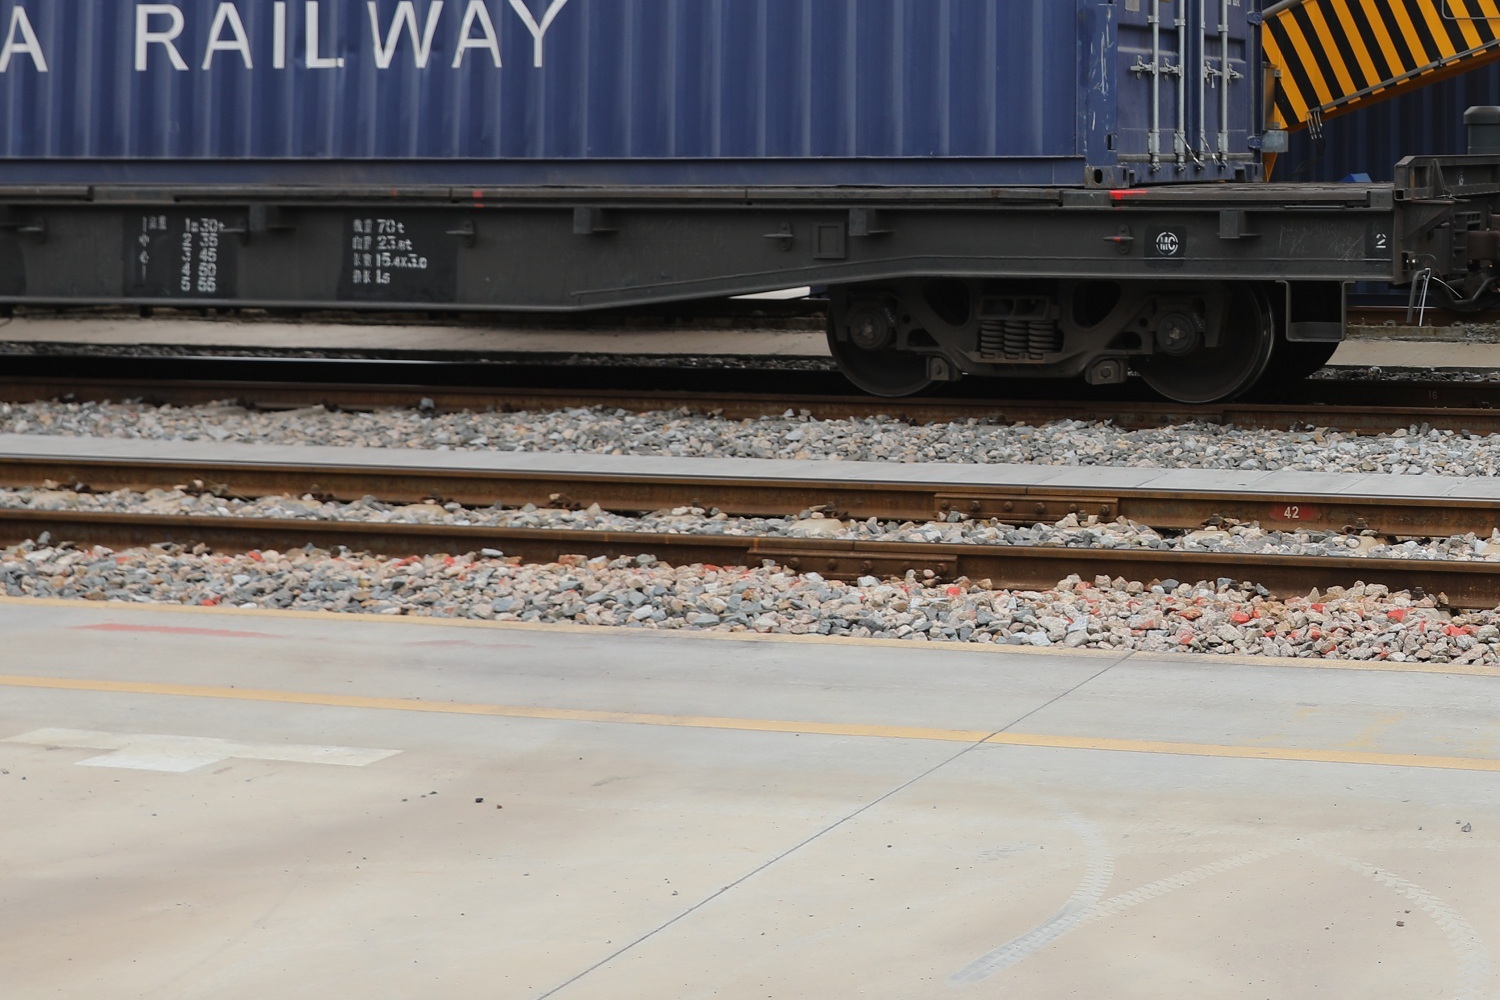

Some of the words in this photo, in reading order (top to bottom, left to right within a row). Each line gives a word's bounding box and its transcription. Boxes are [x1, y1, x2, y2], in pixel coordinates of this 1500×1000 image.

[377, 219, 405, 234] 70t
[1375, 233, 1387, 249] 2
[1283, 506, 1300, 519] 42
